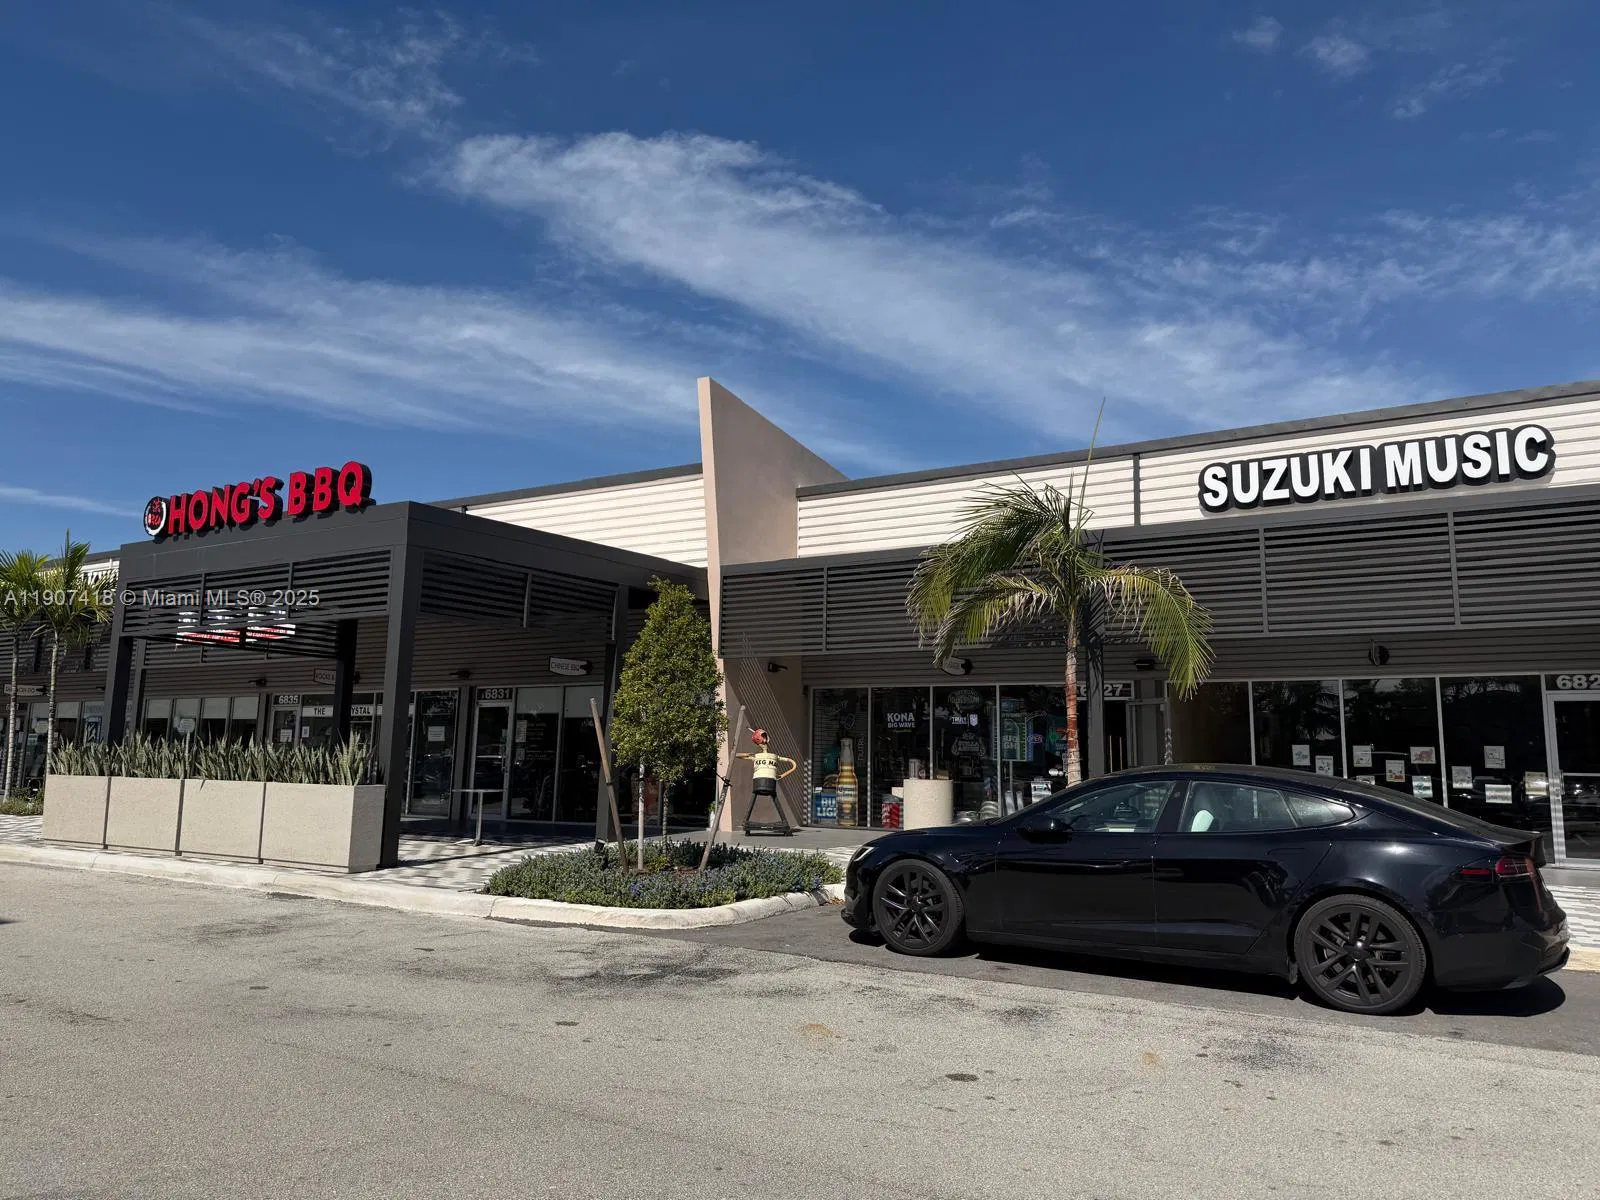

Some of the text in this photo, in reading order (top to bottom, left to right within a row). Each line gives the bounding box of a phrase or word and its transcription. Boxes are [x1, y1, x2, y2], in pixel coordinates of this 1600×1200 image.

[1202, 425, 1550, 508] SUZUKI MUSIC
[167, 475, 279, 535] HONG'S
[287, 460, 365, 517] BBQ
[1080, 683, 1124, 697] 627
[278, 694, 299, 705] 6835
[314, 706, 370, 716] THE YSTAL
[886, 712, 916, 723] KONA
[821, 797, 836, 807] BU
[816, 807, 837, 817] LIG
